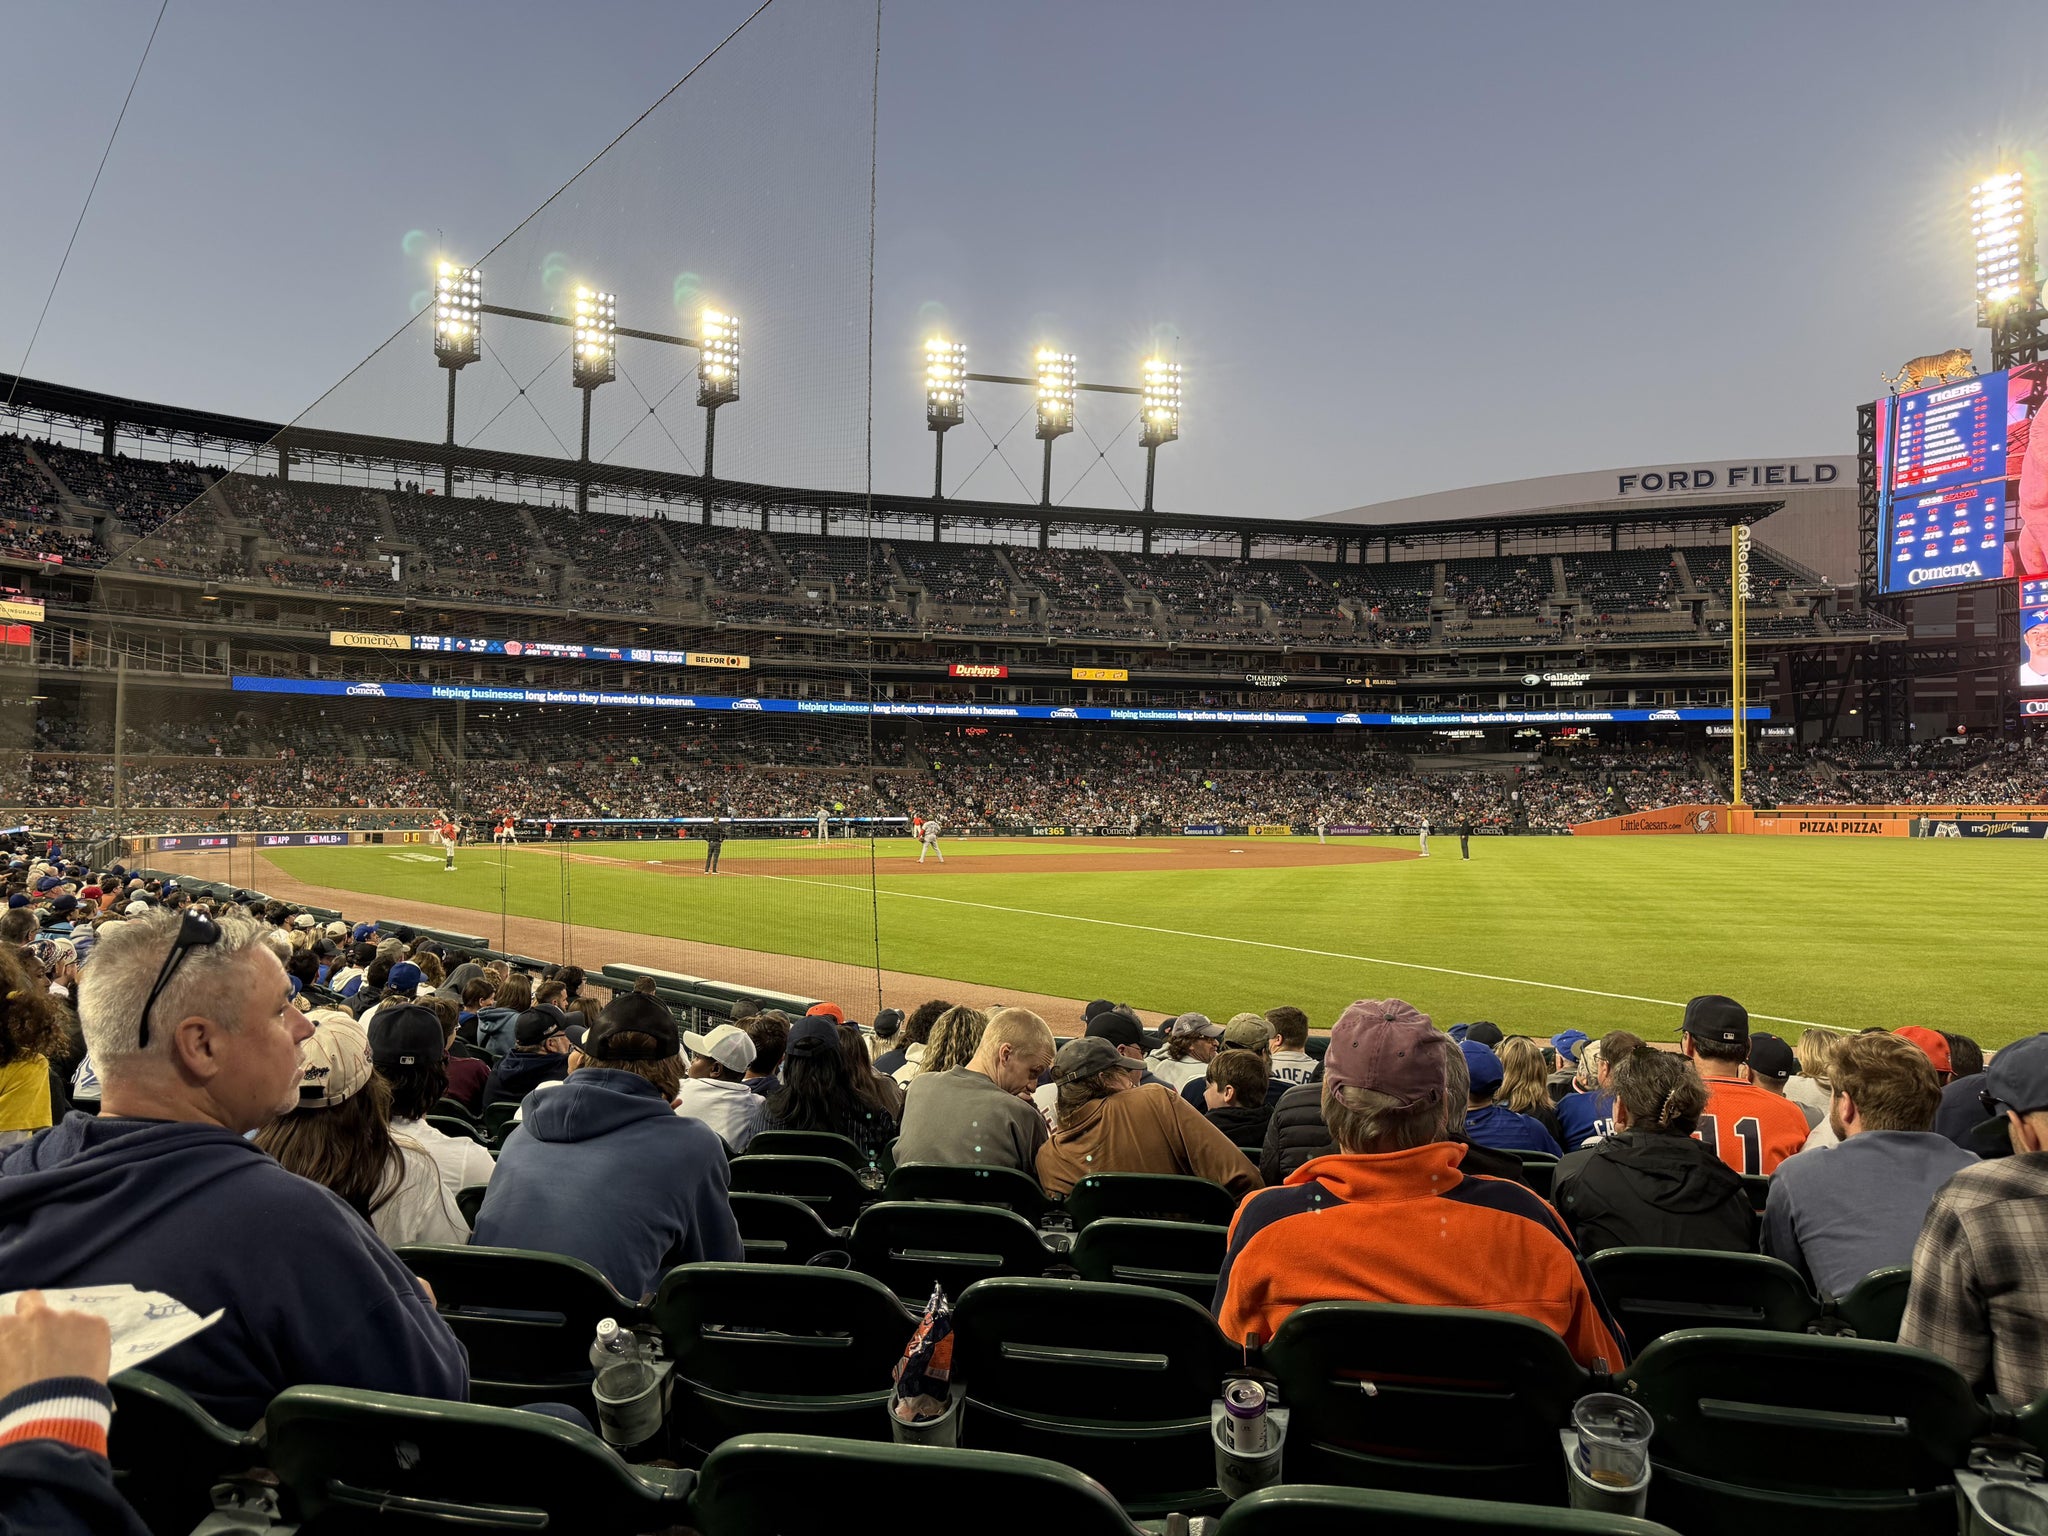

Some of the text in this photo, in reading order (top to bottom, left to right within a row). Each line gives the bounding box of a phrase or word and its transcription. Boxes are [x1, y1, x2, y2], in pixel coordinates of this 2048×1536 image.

[1927, 382, 1982, 404] TIGERS
[1923, 460, 1967, 474] TORKELSON
[1618, 463, 1840, 495] FORD FIELD
[1943, 489, 1978, 501] SEASON
[1738, 540, 1752, 599] Rocket
[8, 608, 42, 617] INSURANCE
[420, 635, 440, 643] TOR
[470, 639, 487, 647] 1-0
[535, 643, 583, 652] TORKELSON
[695, 656, 725, 665] BELFOR
[955, 664, 1000, 675] Dunham's
[1245, 674, 1288, 682] CHAMPIONS
[1543, 672, 1591, 682] Gallagher
[432, 687, 696, 706] Helping businesses long before they invented the homerun.
[798, 701, 1019, 716] Helping businesses long before they invented the homerun.
[1110, 710, 1307, 721] Helping businesses long before they invented the homerun.
[1391, 712, 1614, 724] Helping businesses long before they invented the homerun.
[1713, 726, 1734, 735] Modelo
[1330, 826, 1369, 835] planet fitness
[1620, 819, 1640, 831] Little
[1799, 821, 1882, 833] PIZZA! PIZZA!
[1971, 825, 1983, 833] IT'S
[1982, 822, 2017, 836] Miller
[1033, 827, 1065, 835] bet365
[277, 836, 289, 844] APP
[318, 835, 341, 843] MLB+
